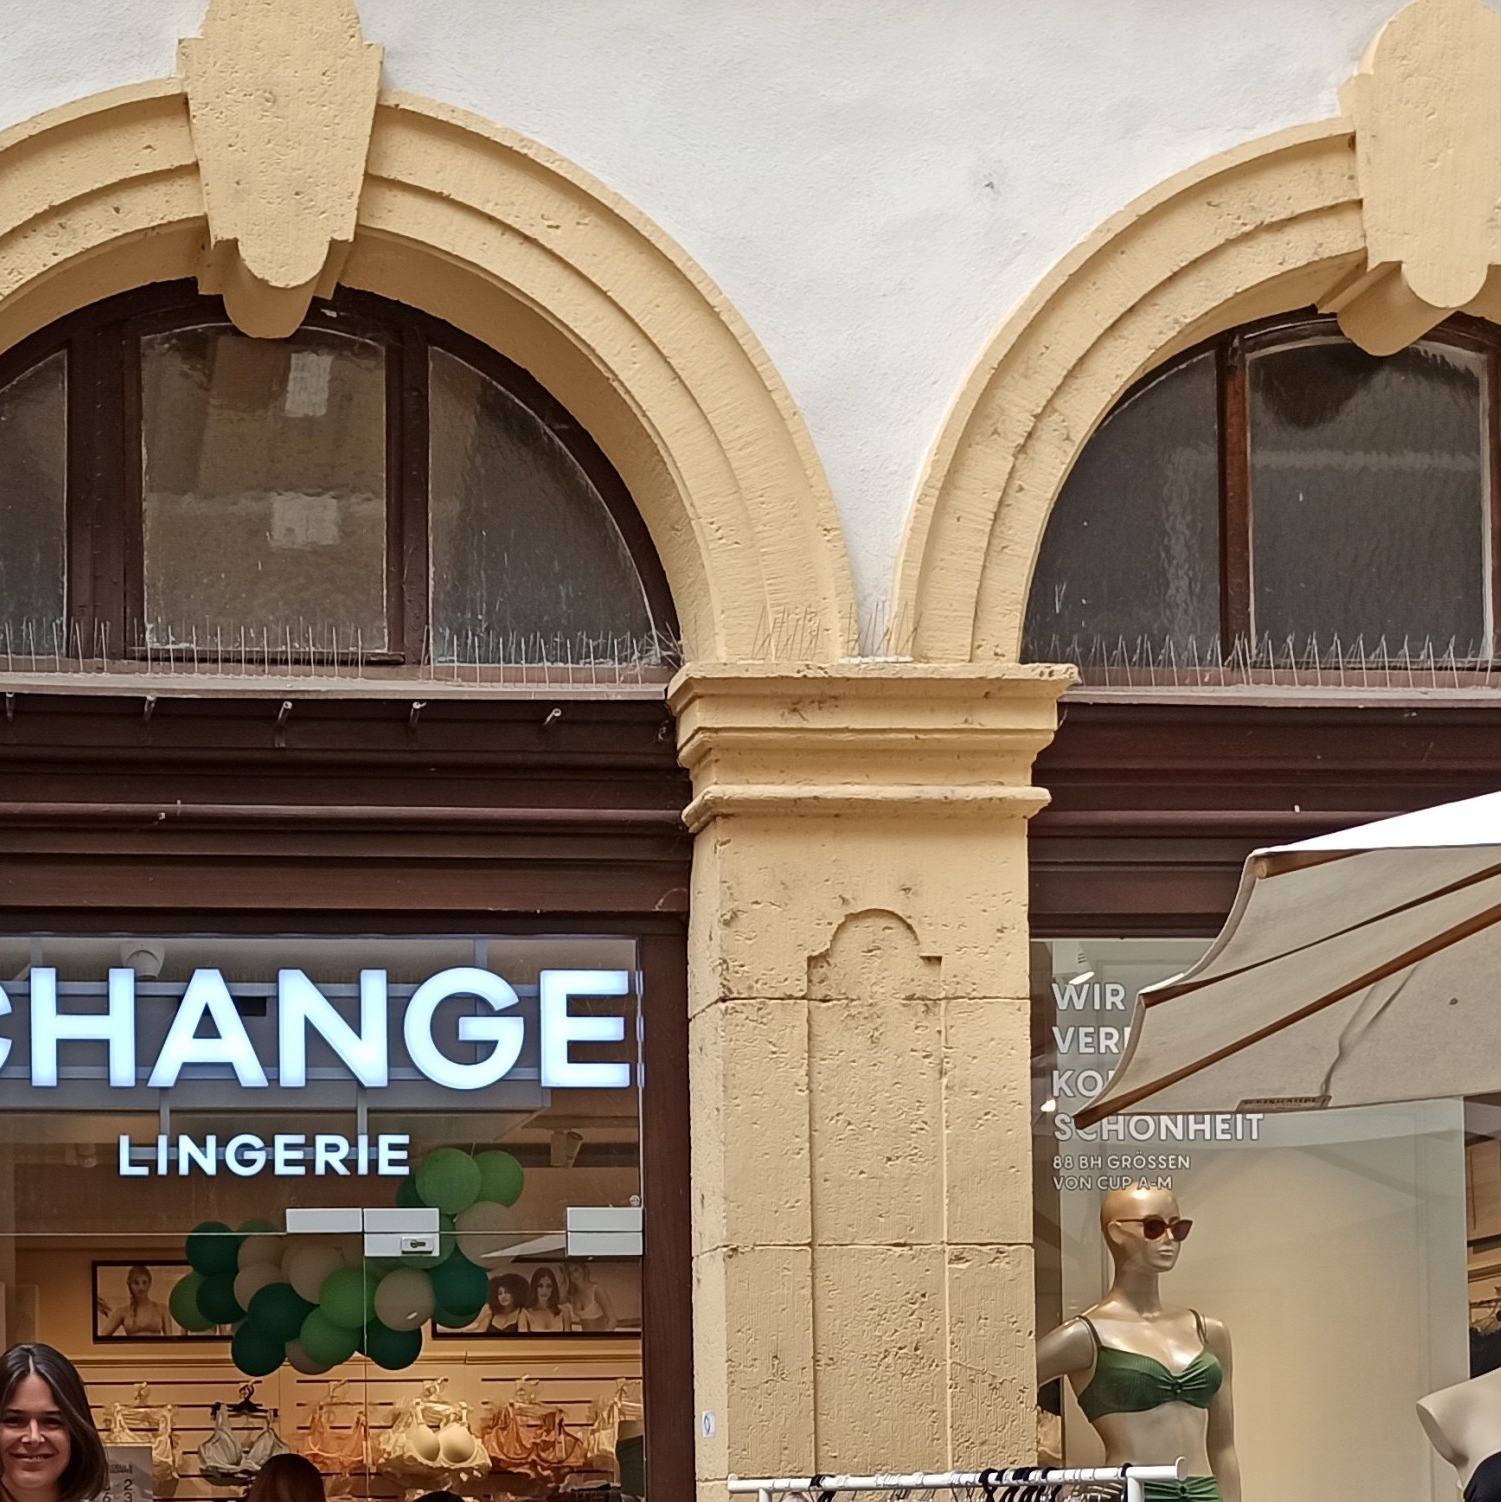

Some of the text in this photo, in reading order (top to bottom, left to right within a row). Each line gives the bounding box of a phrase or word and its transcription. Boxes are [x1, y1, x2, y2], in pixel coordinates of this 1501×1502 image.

[1051, 982, 1127, 1011] WIR
[1051, 1026, 1131, 1054] VER
[1051, 1069, 1115, 1098] KO
[118, 1134, 411, 1177] LINGERIE
[1052, 1150, 1192, 1170] 88 BH GRÖSSEN
[1052, 1176, 1174, 1191] VON CUP A-M
